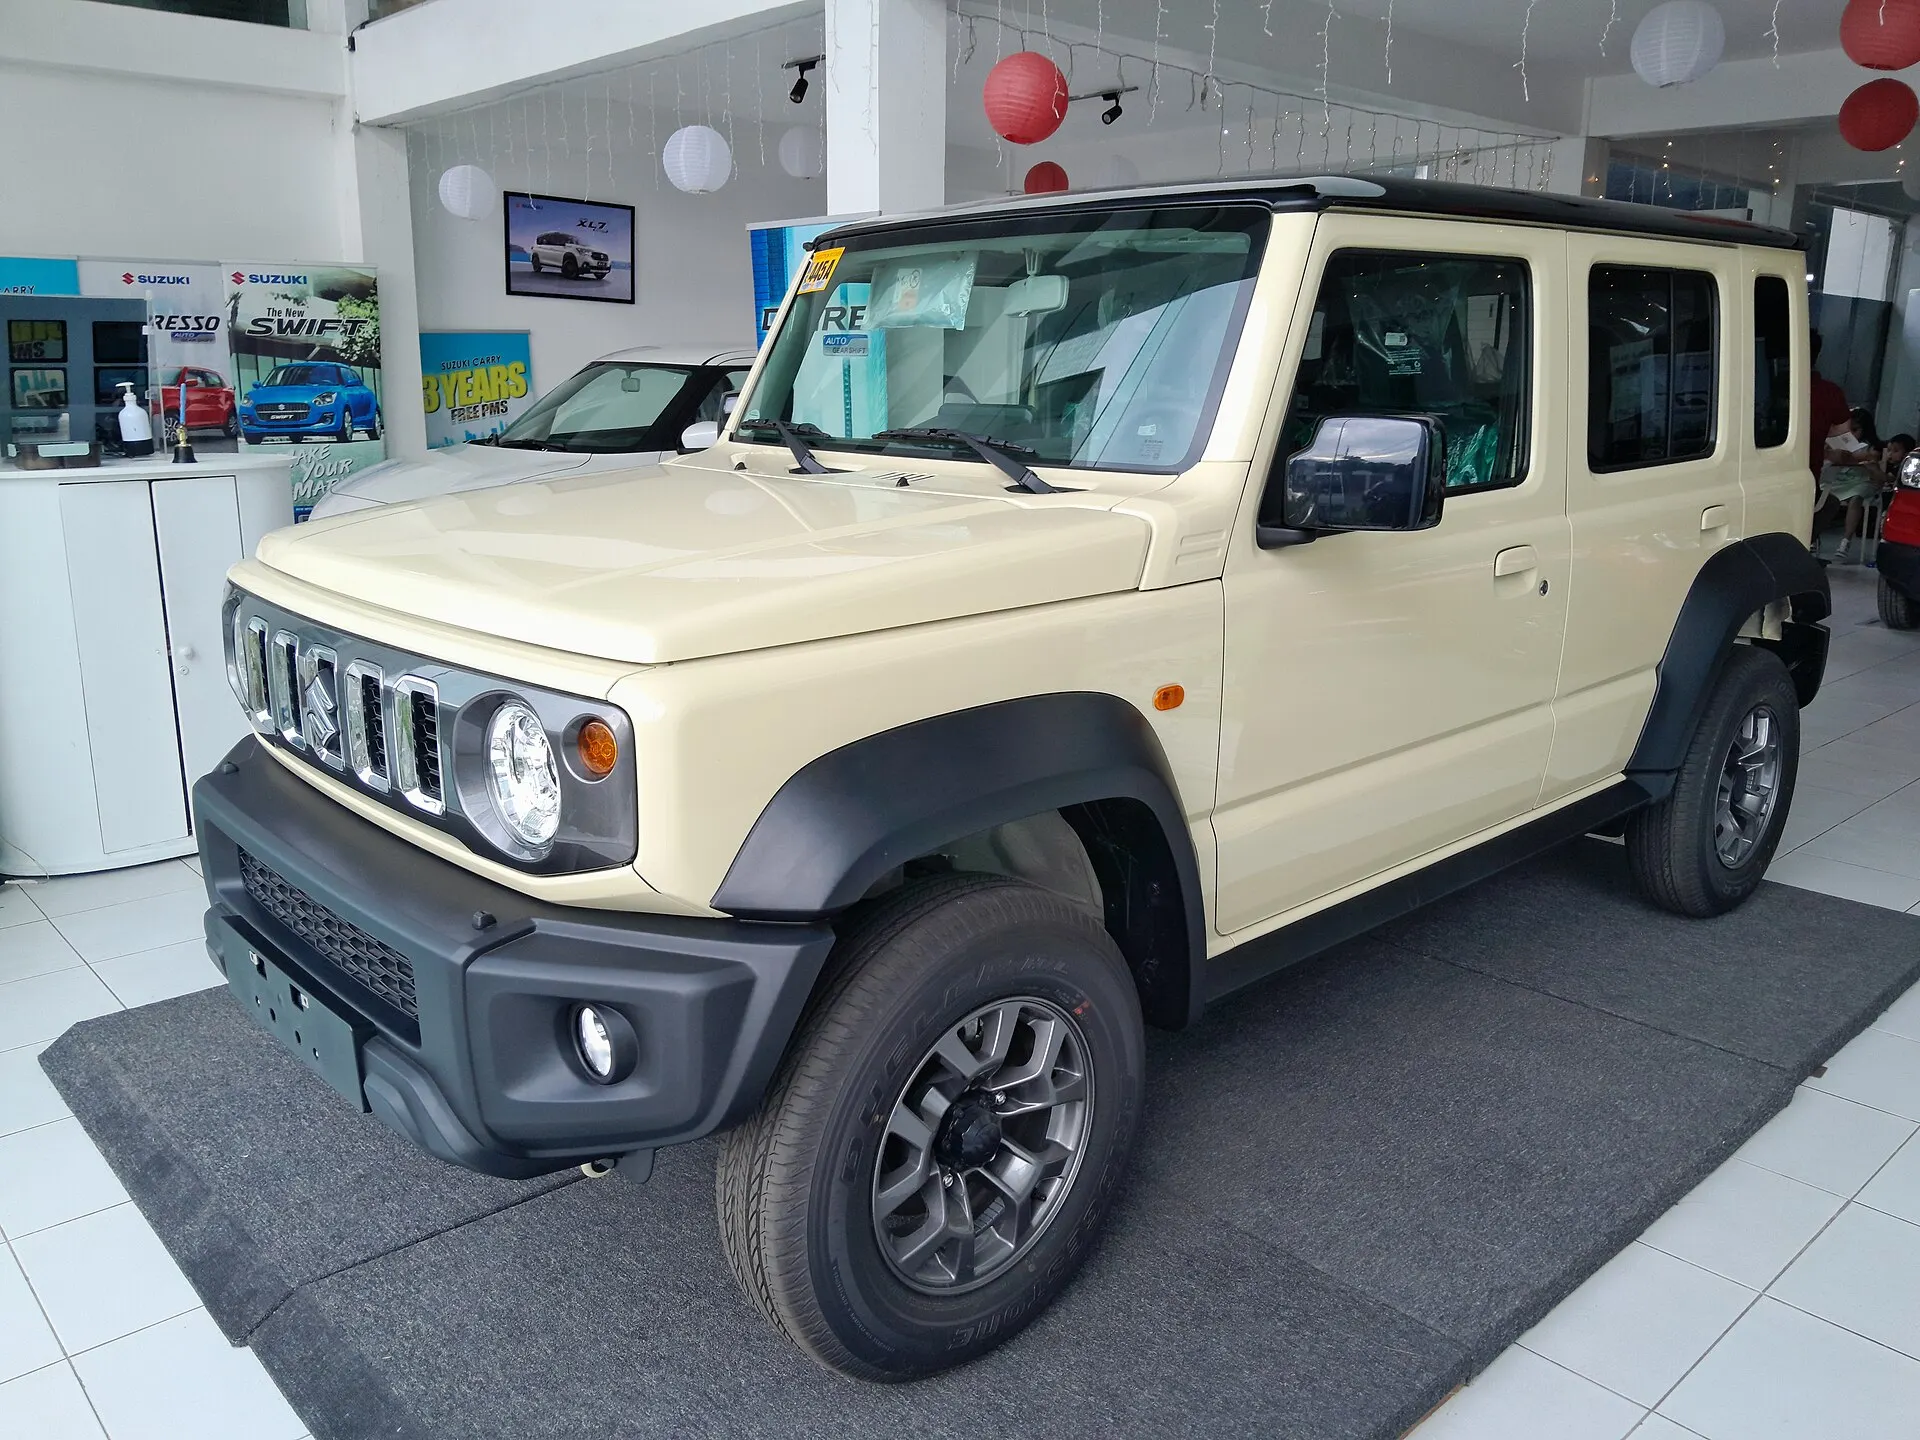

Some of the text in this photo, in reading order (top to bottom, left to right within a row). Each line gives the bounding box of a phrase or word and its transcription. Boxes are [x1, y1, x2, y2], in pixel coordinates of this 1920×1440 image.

[576, 219, 606, 231] XL7
[137, 274, 190, 285] SUZUKI
[248, 273, 308, 285] SUZUKI
[266, 307, 305, 318] The New
[245, 317, 371, 337] SWIFT
[825, 337, 847, 345] AUTO
[441, 355, 501, 371] SUZUKI CARRY
[422, 360, 528, 414] 3 YEARS
[450, 400, 509, 422] FREE PMS
[299, 458, 354, 484] YOUR
